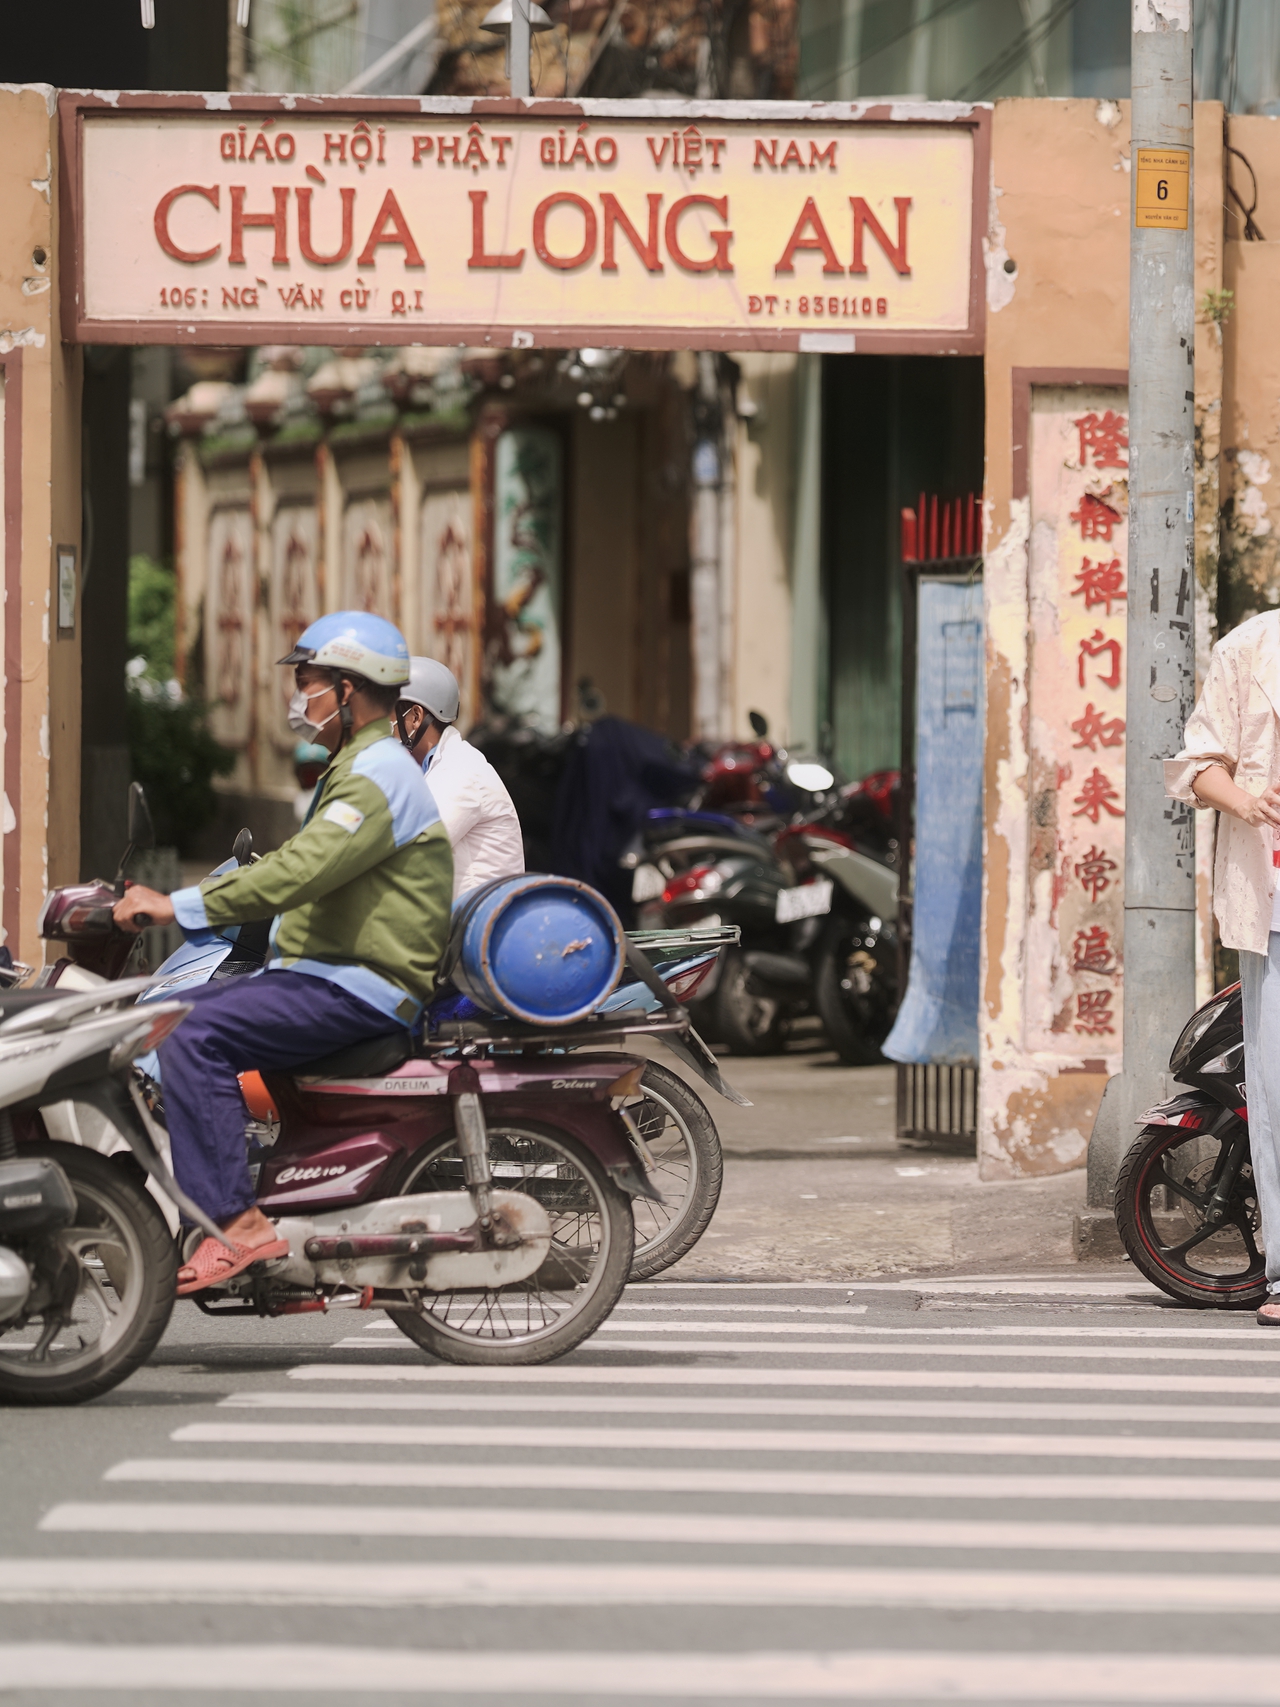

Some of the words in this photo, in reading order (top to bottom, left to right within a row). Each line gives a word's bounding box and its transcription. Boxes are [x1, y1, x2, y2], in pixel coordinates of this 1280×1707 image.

[220, 118, 296, 161] GIÁO
[324, 119, 388, 170] HỘI
[412, 121, 513, 169] PHẬT
[540, 121, 618, 165] GIÁO
[647, 124, 727, 175] VIỆT
[753, 138, 838, 169] NAM
[1157, 179, 1168, 201] 6
[153, 164, 425, 267] CHÙA
[467, 190, 735, 272] LONG
[775, 195, 914, 276] AN
[277, 282, 323, 308] VĂN
[385, 1078, 430, 1090] DAELIM
[551, 1078, 598, 1090] Deluxe
